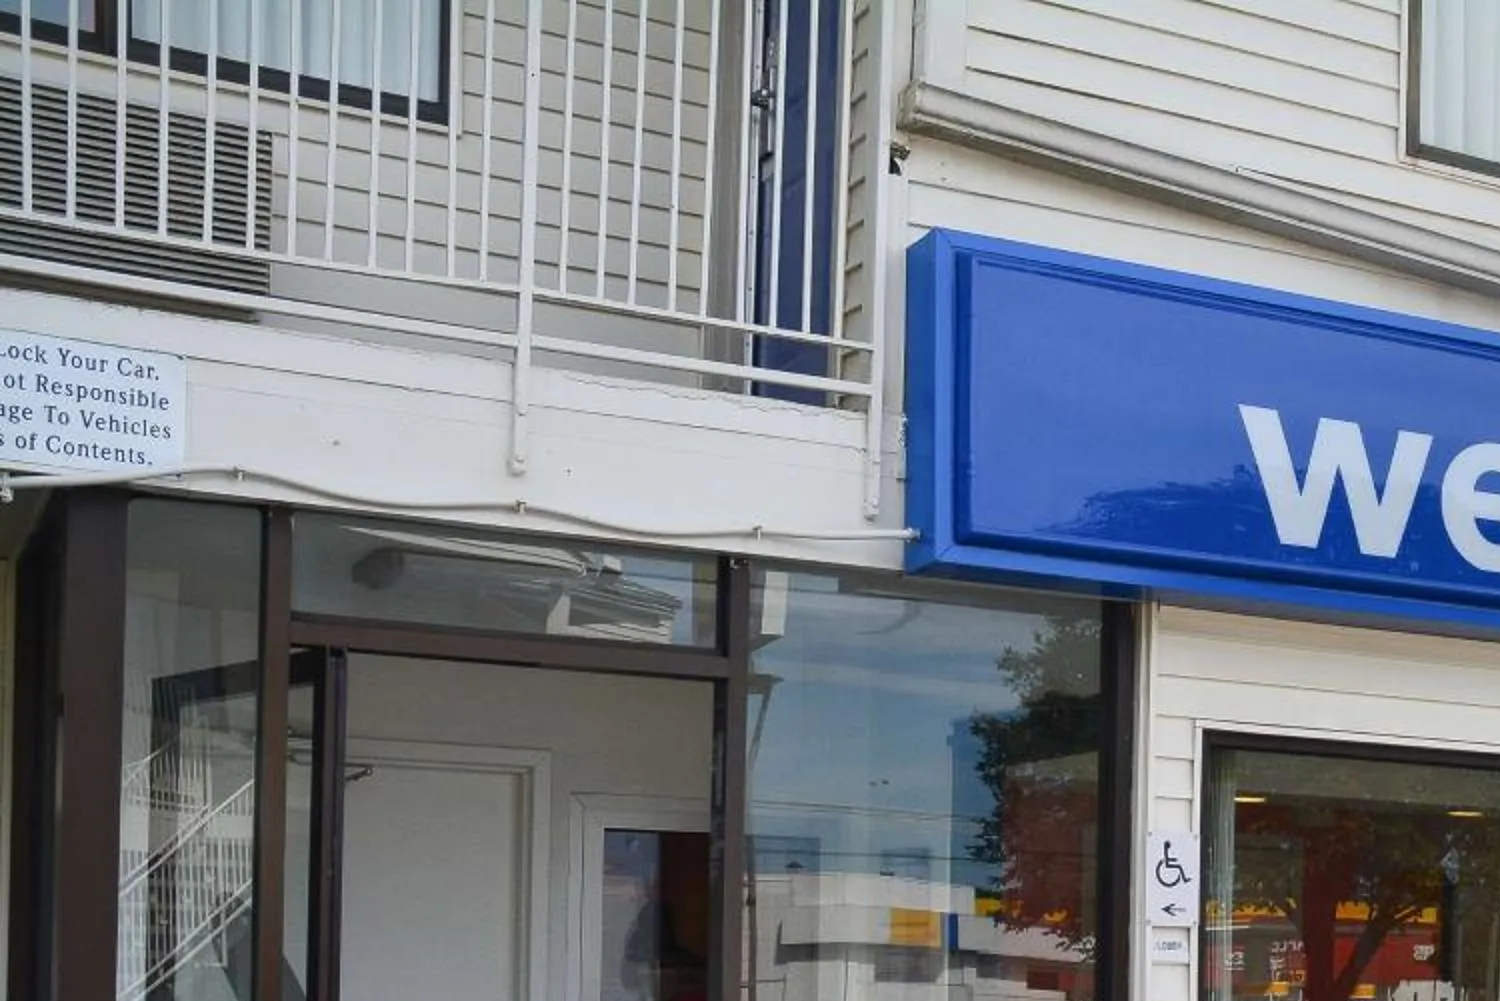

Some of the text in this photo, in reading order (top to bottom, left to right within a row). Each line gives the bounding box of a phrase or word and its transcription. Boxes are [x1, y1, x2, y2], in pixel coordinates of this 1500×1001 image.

[0, 345, 159, 380] ock Your Car.
[36, 373, 170, 411] Responsible
[44, 404, 70, 426] To
[80, 409, 171, 439] Vehicles
[15, 432, 38, 451] of
[45, 434, 153, 466] Contents.
